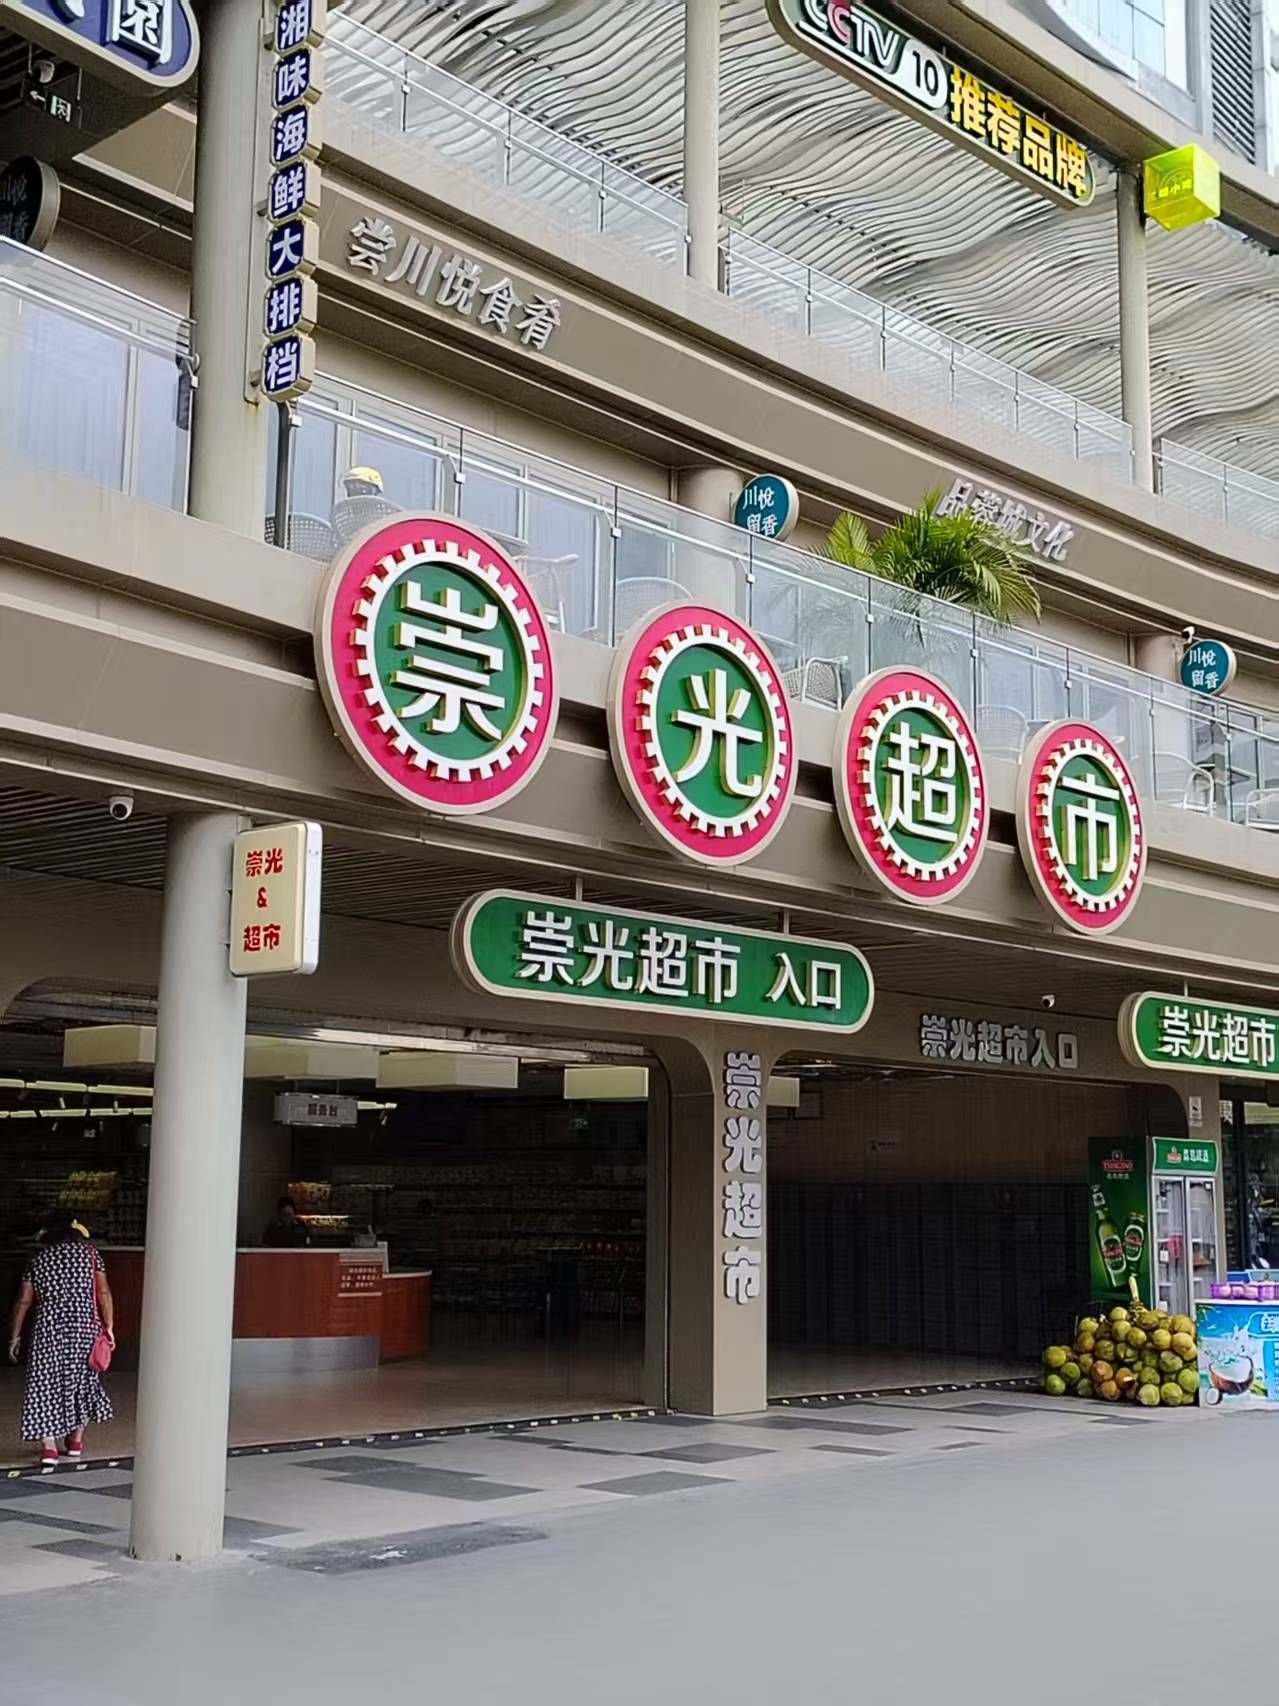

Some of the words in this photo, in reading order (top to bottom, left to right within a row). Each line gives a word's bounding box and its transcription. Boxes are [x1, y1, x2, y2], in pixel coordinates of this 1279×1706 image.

[803, 0, 900, 68] CCTV
[911, 50, 940, 97] 10
[950, 65, 1089, 199] 推荐品牌
[267, 0, 309, 390] 湘味海鲜大排档
[347, 217, 561, 350] 尝川悦食肴
[742, 485, 775, 510] 川悦
[747, 513, 778, 536] 留香
[1187, 647, 1217, 668] 川悦
[1191, 669, 1220, 689] 留香
[245, 848, 284, 877] 崇光
[257, 886, 268, 908] &
[243, 923, 281, 952] 超市
[515, 910, 741, 1003] 崇光超市
[765, 952, 842, 1010] 入口
[920, 1014, 1078, 1069] 崇光超市入口
[1158, 1005, 1277, 1067] 崇光超市
[723, 1051, 763, 1305] 崇光超市
